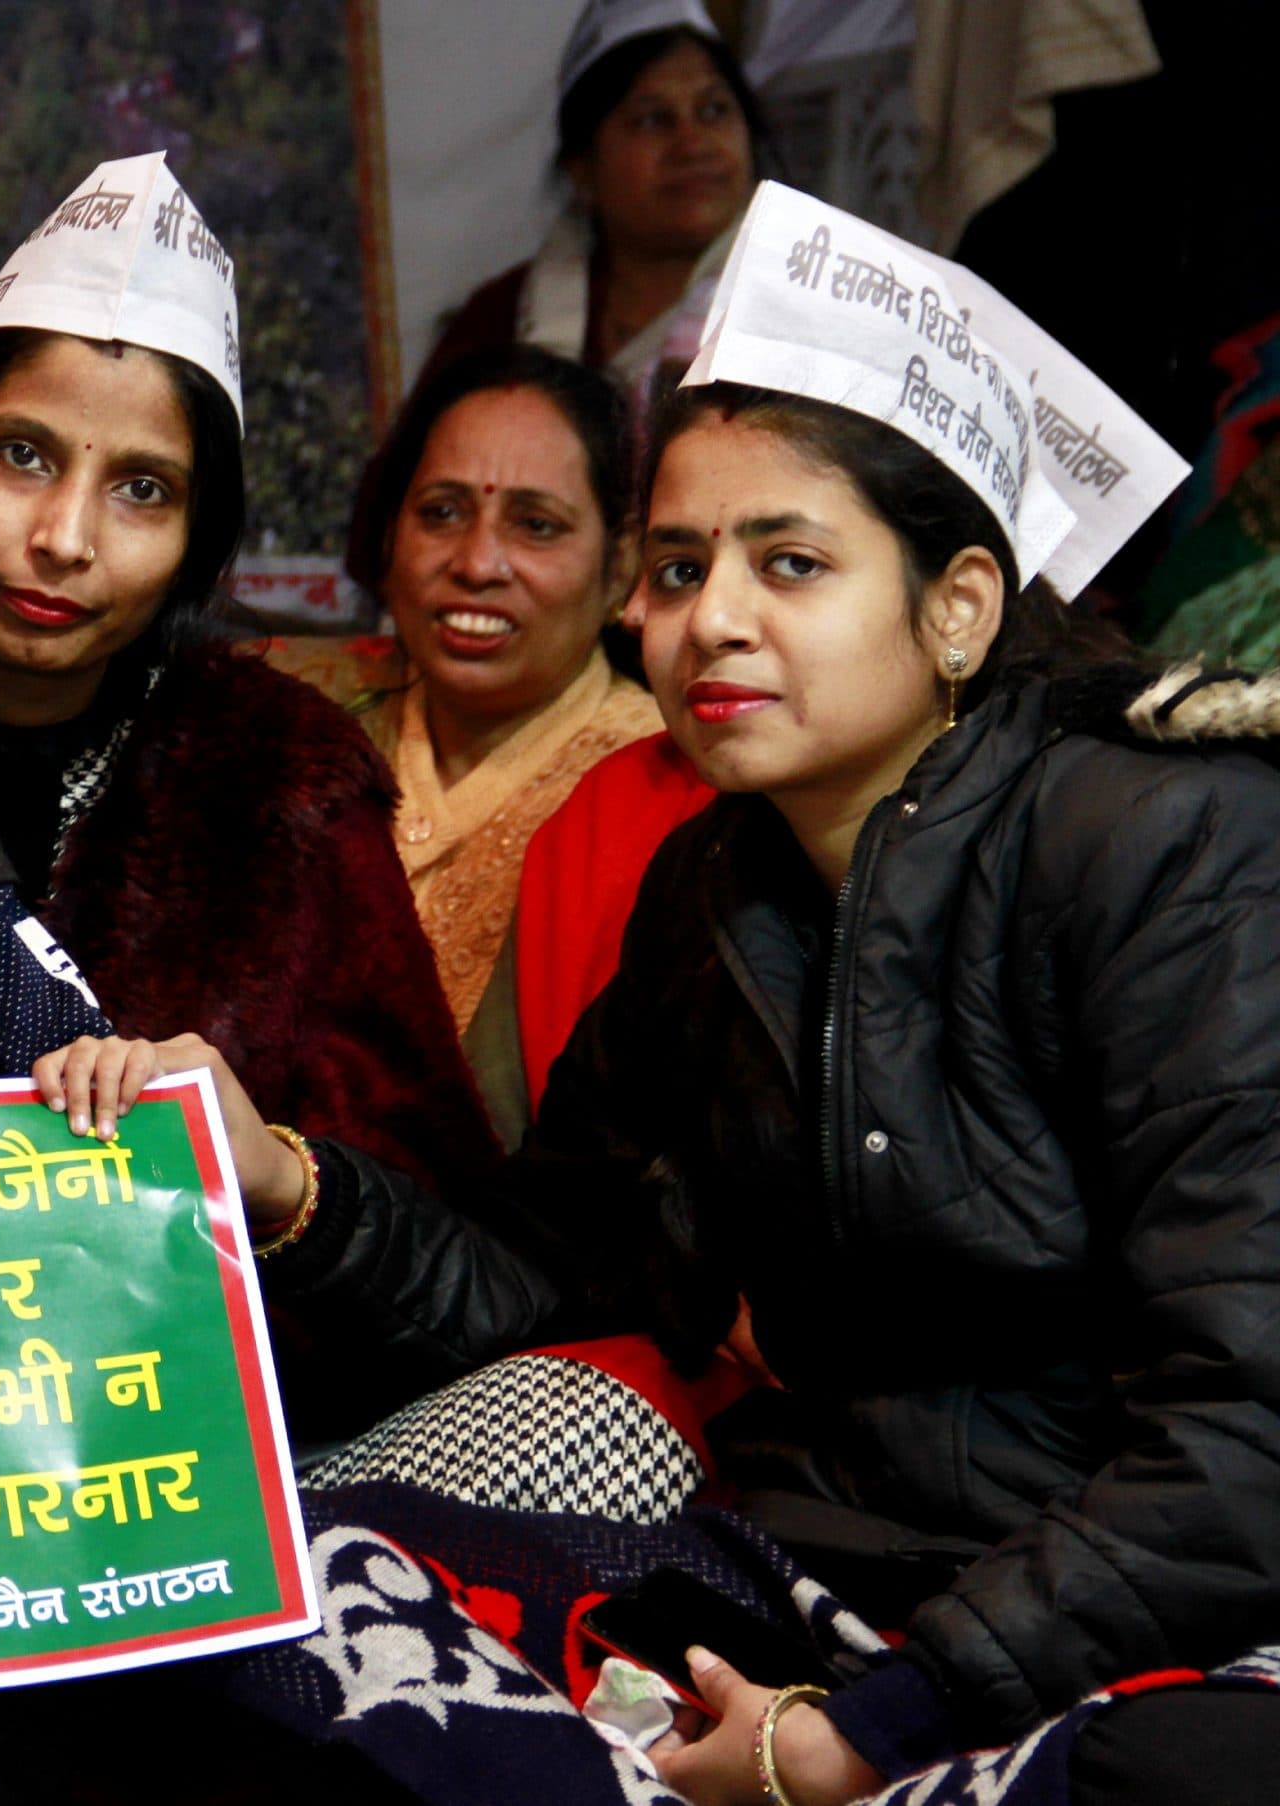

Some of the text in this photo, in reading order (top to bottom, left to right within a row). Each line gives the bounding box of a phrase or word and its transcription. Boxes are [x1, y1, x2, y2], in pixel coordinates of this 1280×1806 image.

[153, 187, 186, 251] श्री
[785, 224, 832, 291] श्री
[830, 252, 915, 324] सम्मेद
[898, 353, 957, 439] विश्व
[957, 400, 994, 475] जैन
[94, 1350, 162, 1412] न
[77, 1558, 234, 1619] संगठन
